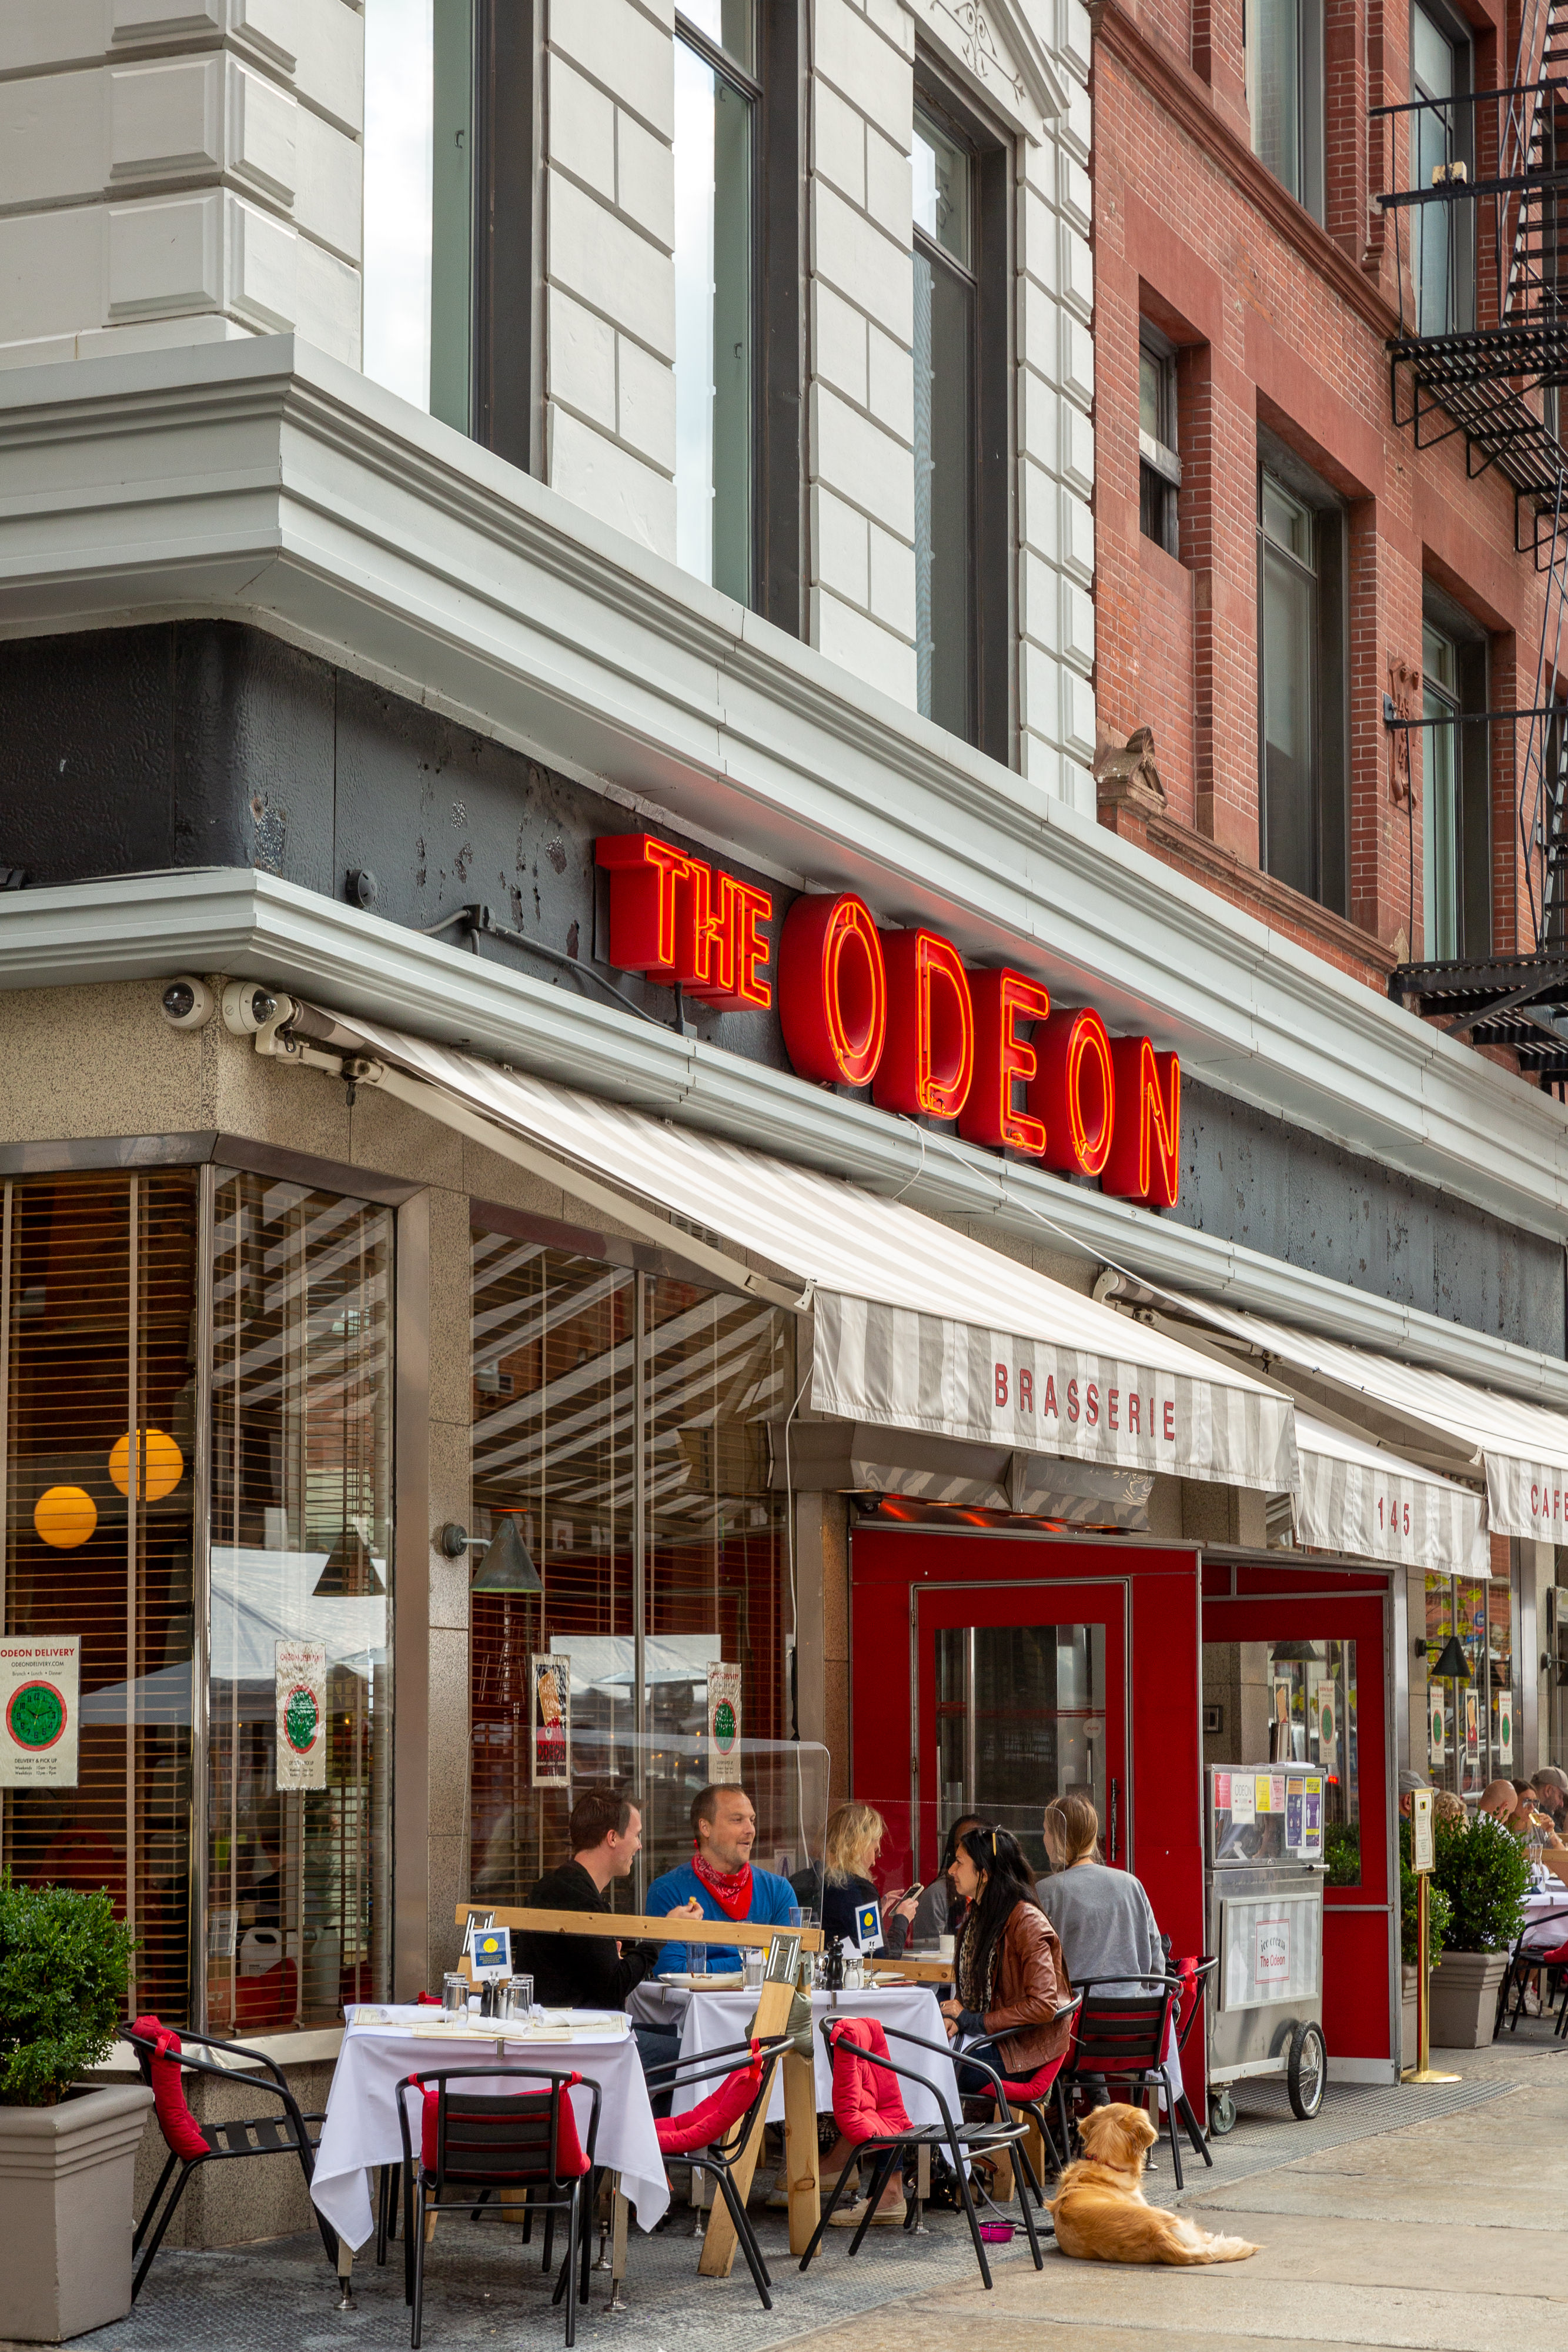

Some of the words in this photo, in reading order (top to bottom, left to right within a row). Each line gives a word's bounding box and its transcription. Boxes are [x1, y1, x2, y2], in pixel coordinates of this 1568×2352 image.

[620, 833, 773, 1011] THE
[791, 891, 1181, 1208] ODEON
[995, 1362, 1175, 1441] BRASSERIE
[1378, 1496, 1410, 1536] 145
[35, 1648, 75, 1656] DELIVERY
[536, 1744, 566, 1761] ODEON
[1235, 1784, 1252, 1796] ODEON
[1261, 1939, 1269, 1953] ice
[1270, 1937, 1286, 1951] cream
[1260, 1955, 1269, 1968] The
[1270, 1953, 1286, 1967] Odeon
